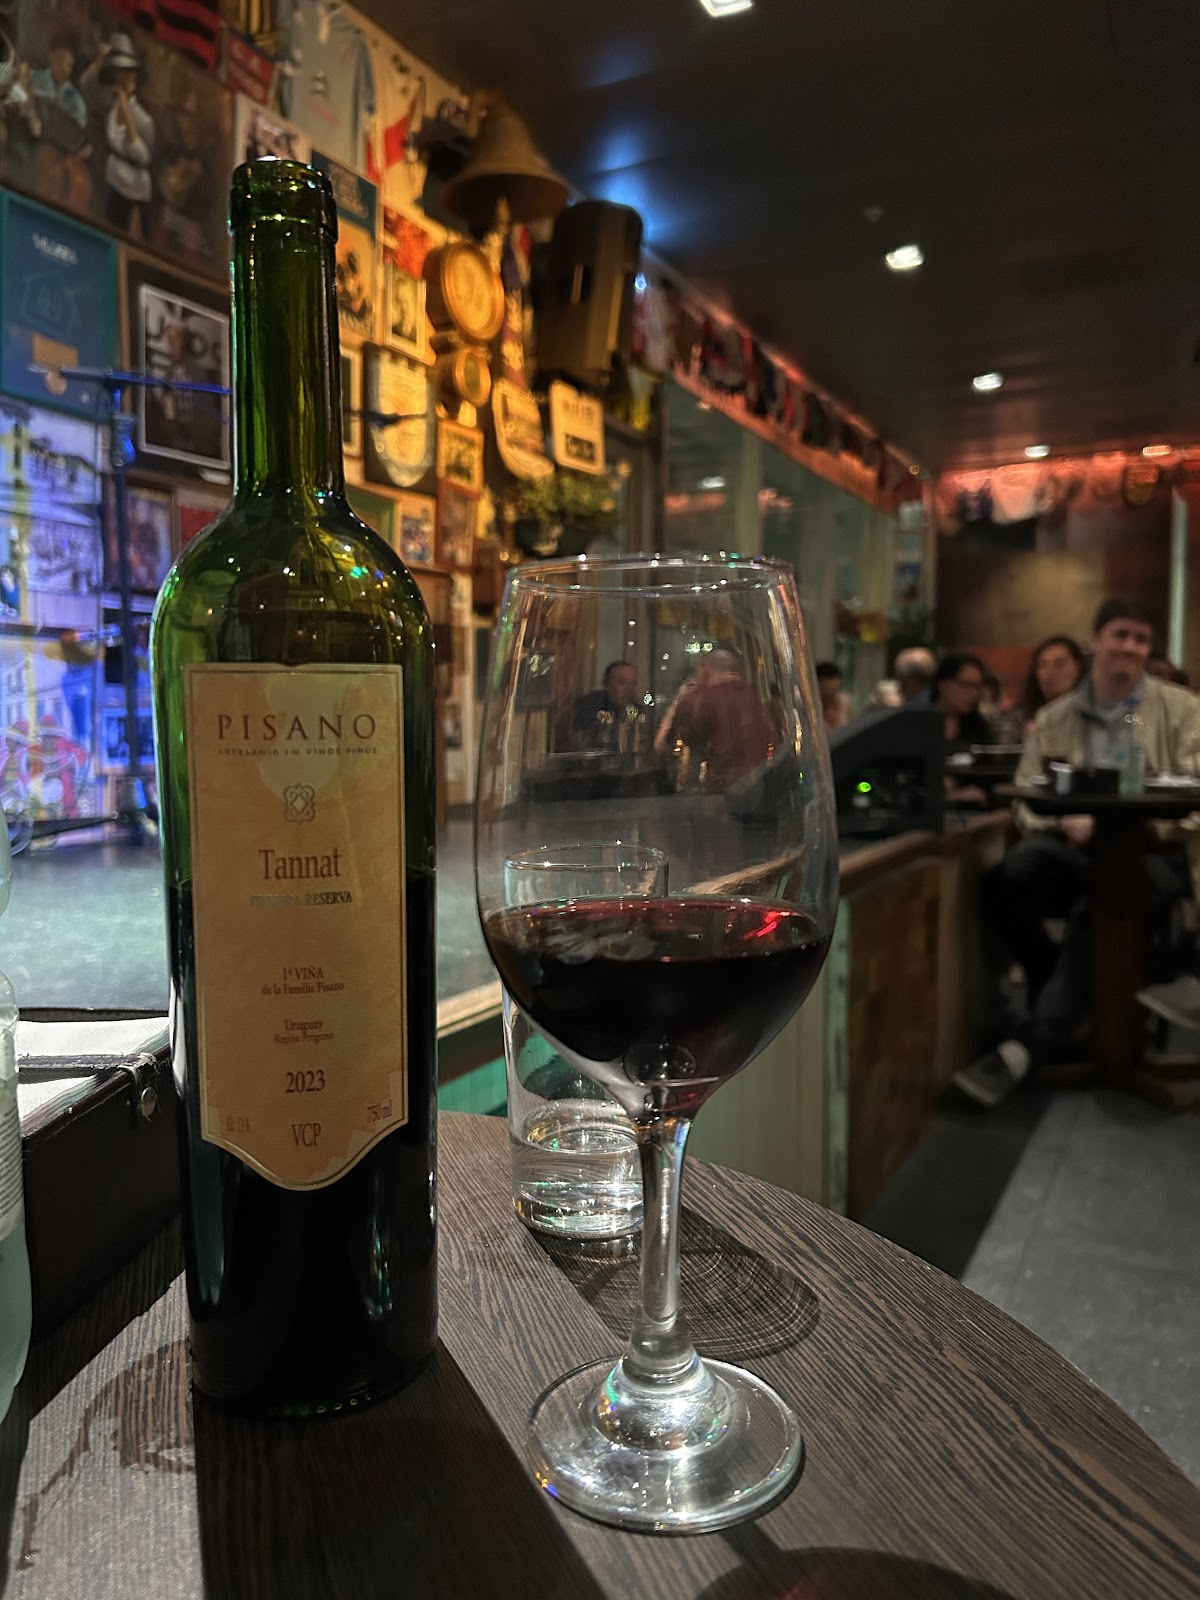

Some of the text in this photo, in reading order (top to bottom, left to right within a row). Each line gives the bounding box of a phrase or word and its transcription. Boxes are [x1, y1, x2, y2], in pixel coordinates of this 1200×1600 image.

[218, 714, 376, 740] PISANO
[307, 747, 341, 755] VINOS
[259, 848, 342, 880] Tannat
[304, 891, 353, 906] RESERVA
[295, 965, 325, 980] VIÑA
[262, 983, 272, 994] de
[274, 983, 281, 994] la
[318, 980, 345, 992] Pisano
[284, 1019, 324, 1034] Uruguay
[285, 1069, 326, 1093] 2023
[291, 1122, 322, 1147] VCP
